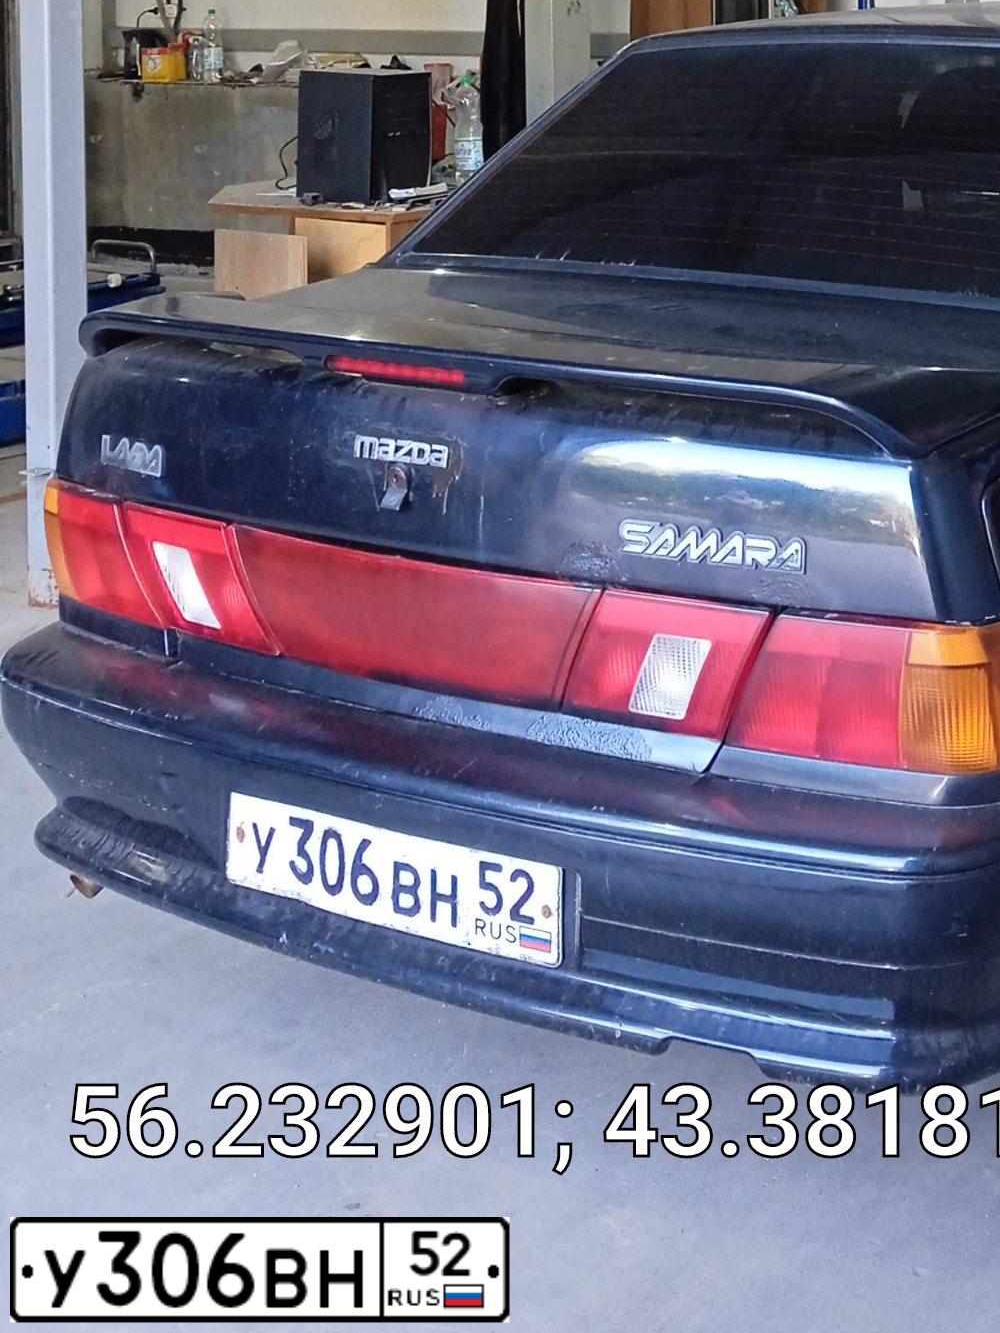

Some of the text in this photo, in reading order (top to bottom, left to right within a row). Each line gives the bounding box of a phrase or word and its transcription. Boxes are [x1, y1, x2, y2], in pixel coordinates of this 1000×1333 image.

[101, 433, 162, 478] LADA
[617, 517, 808, 575] SAMARA
[478, 860, 536, 926] 52
[474, 917, 518, 945] RUS
